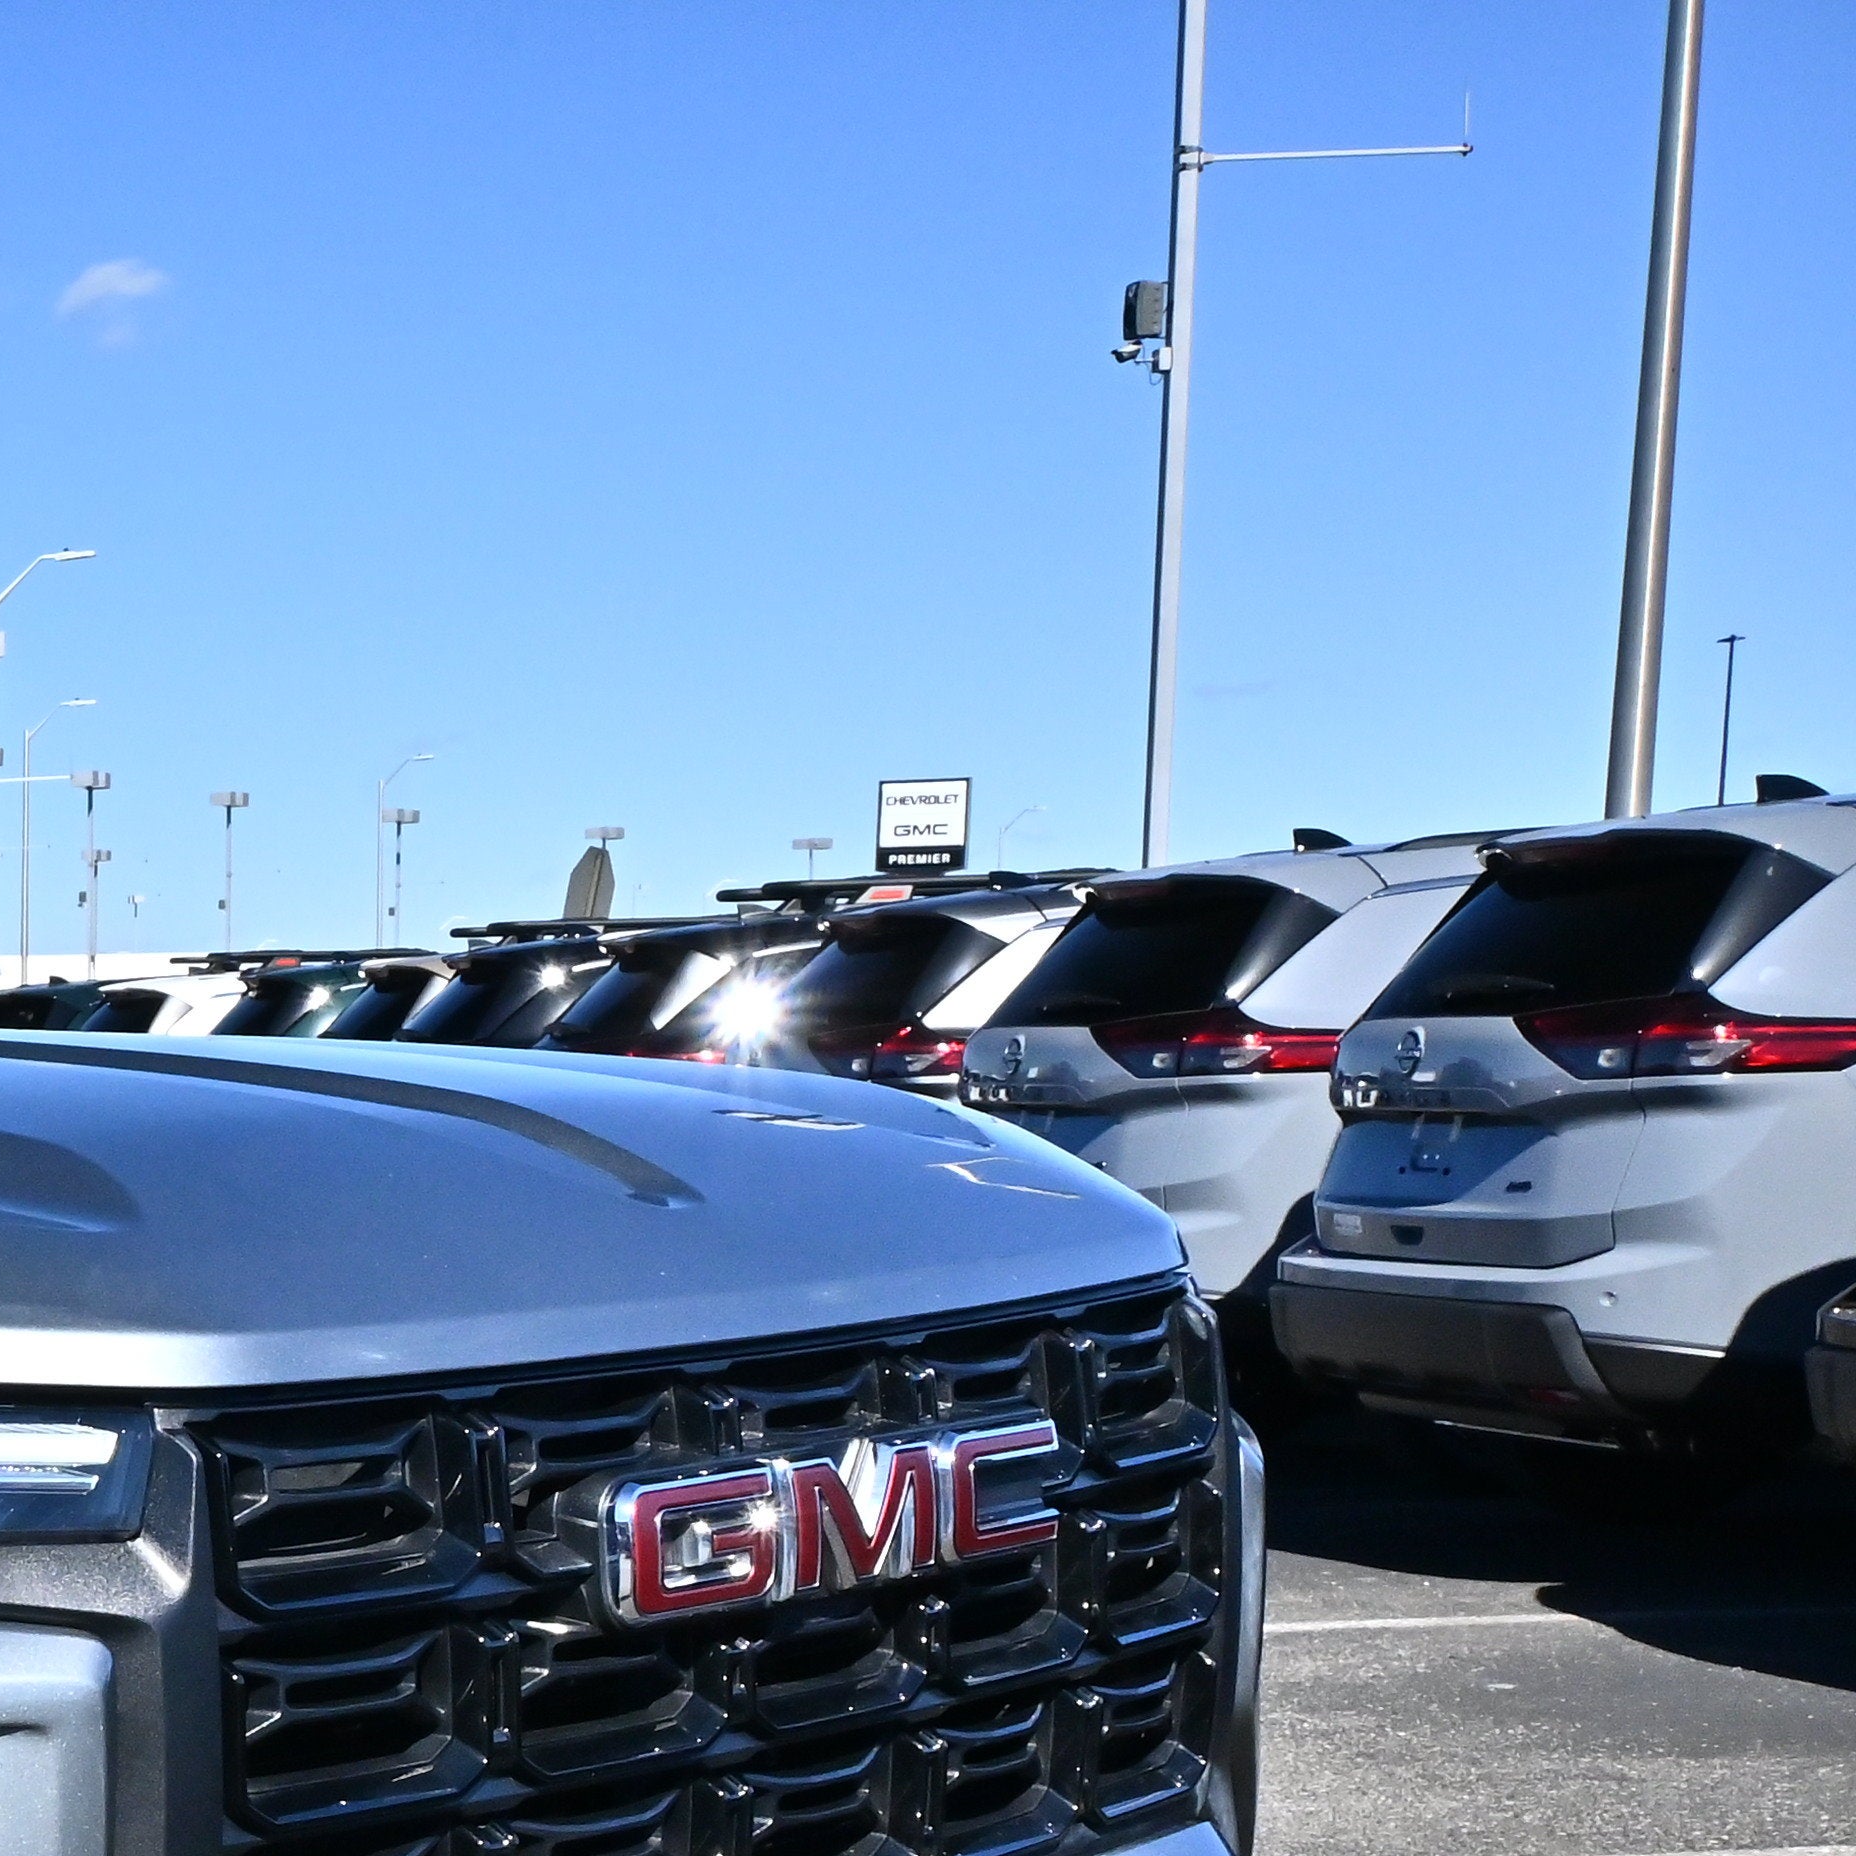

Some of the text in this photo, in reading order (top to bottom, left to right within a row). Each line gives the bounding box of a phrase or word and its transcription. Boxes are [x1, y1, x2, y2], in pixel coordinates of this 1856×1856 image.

[886, 794, 959, 806] CHEVROLET
[894, 823, 948, 836] GMC
[888, 853, 951, 865] PREMIER
[614, 1419, 1059, 1618] GMC
